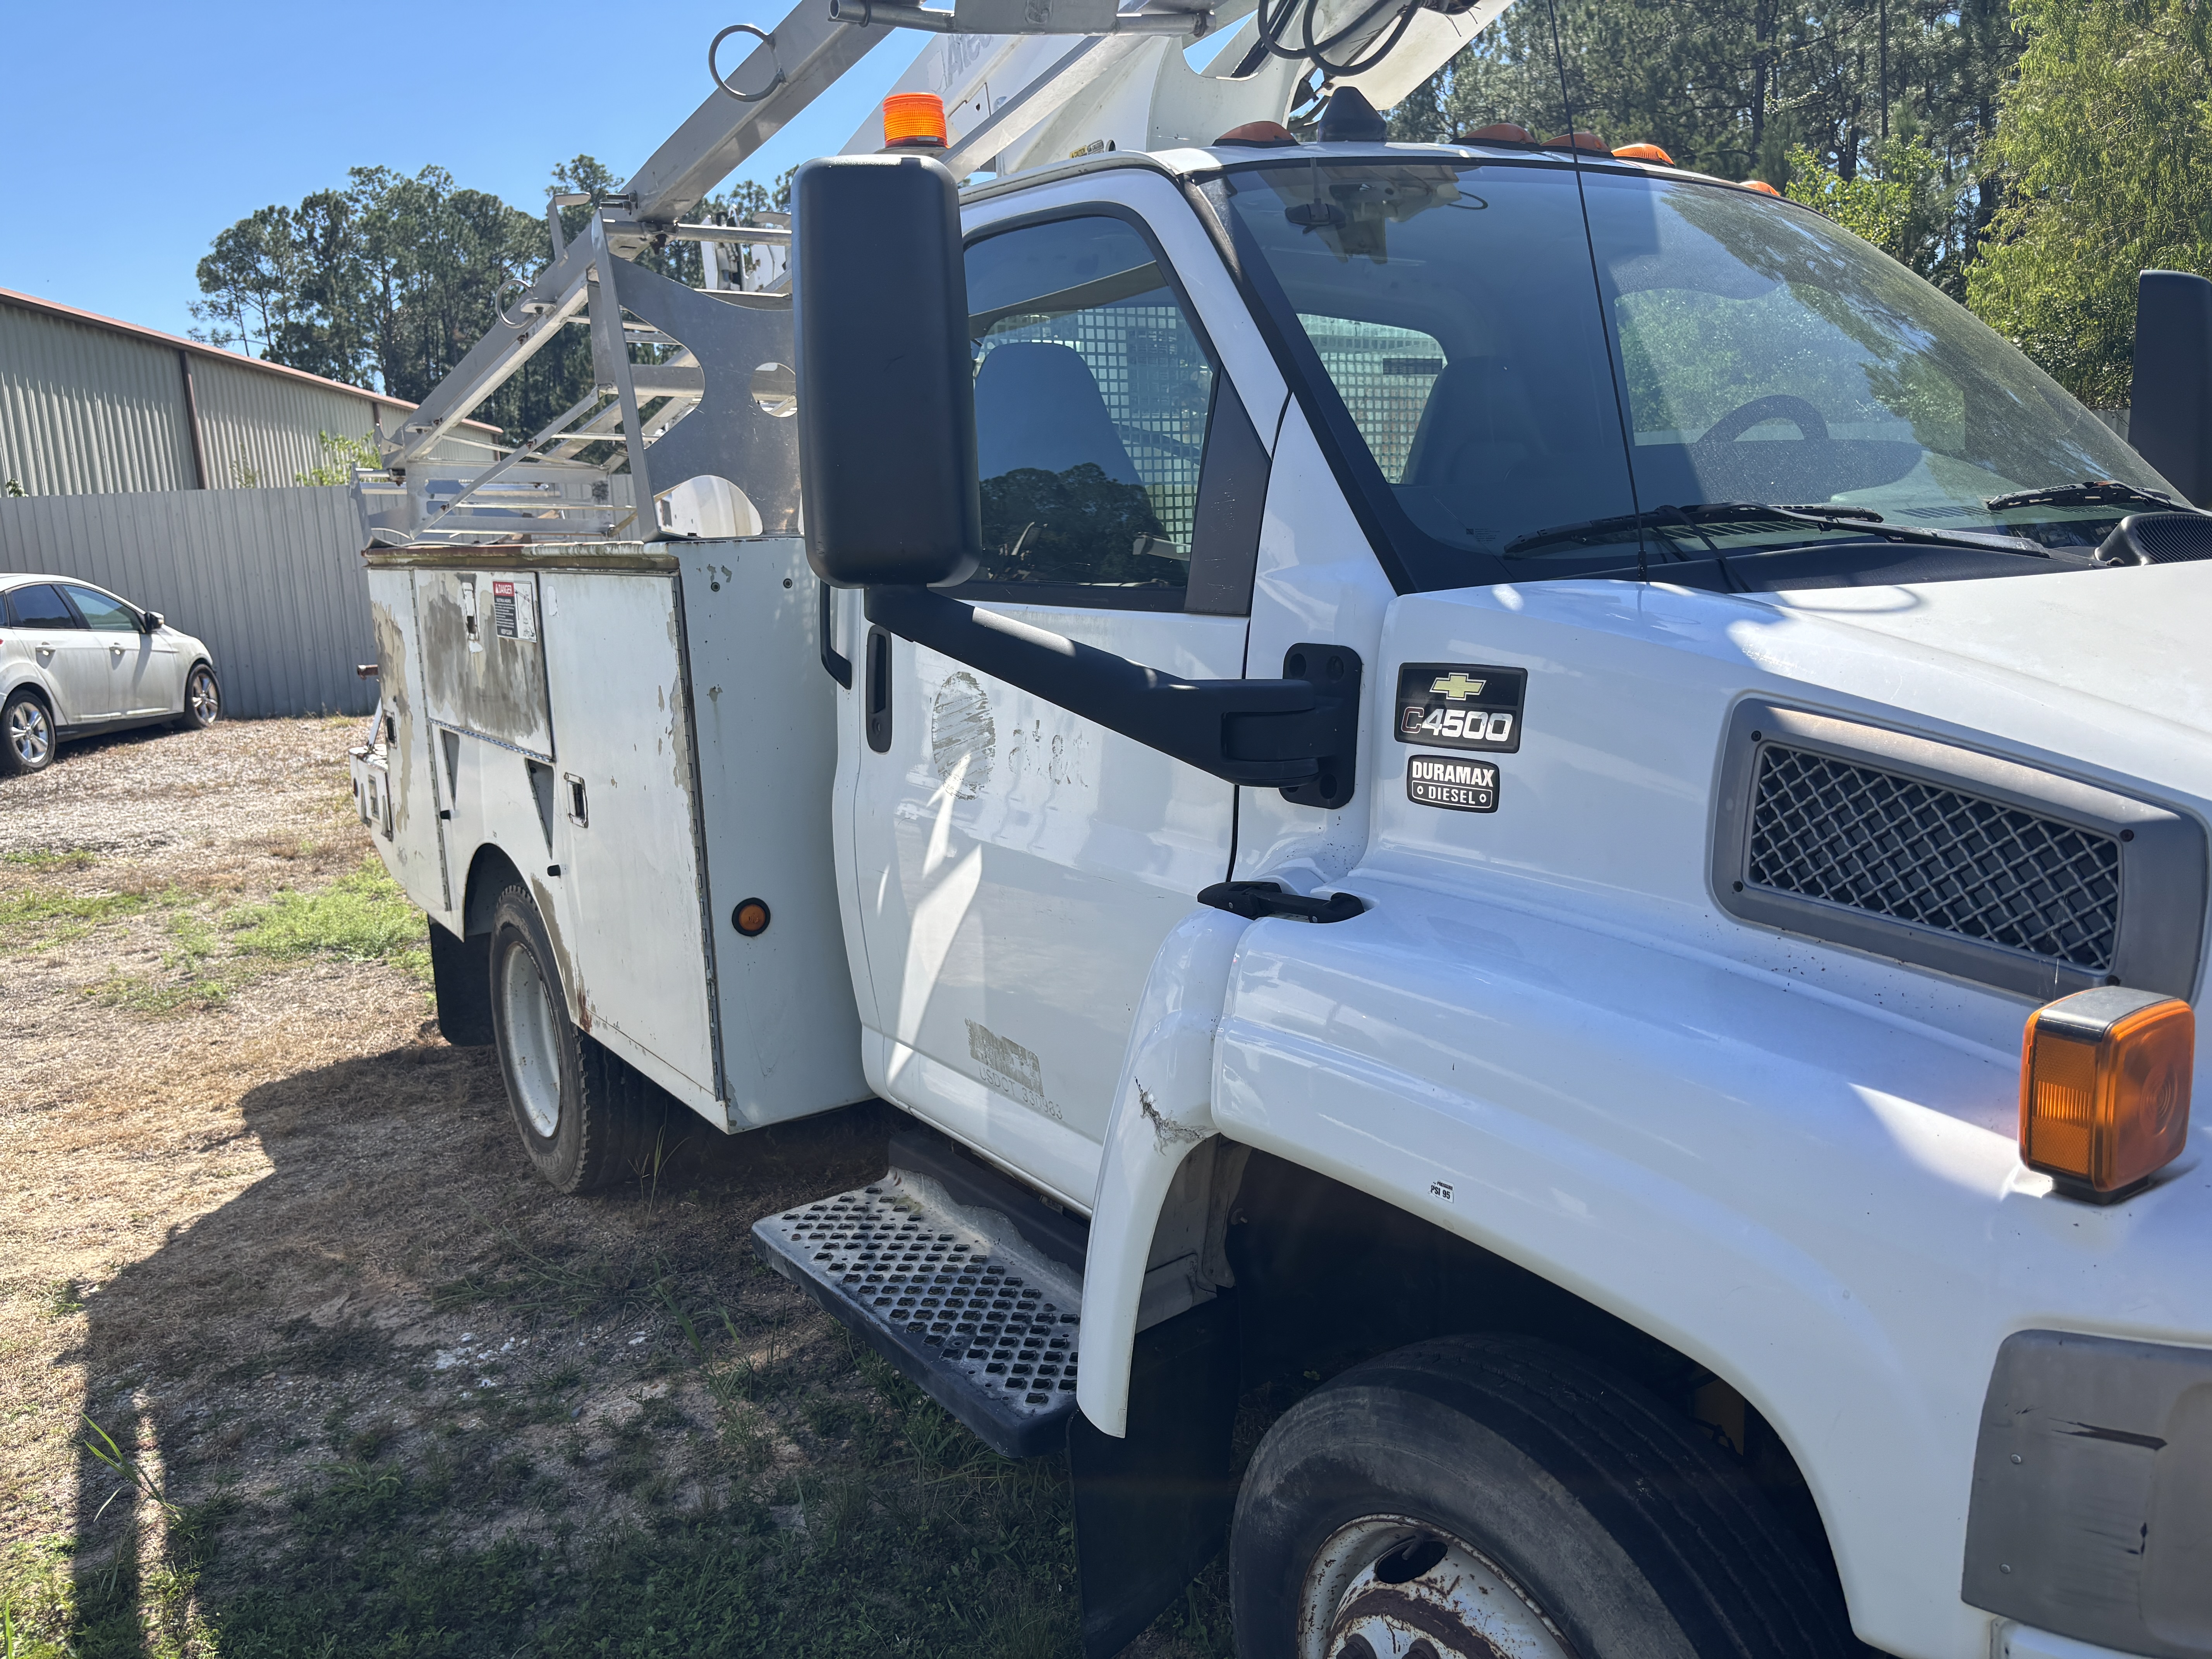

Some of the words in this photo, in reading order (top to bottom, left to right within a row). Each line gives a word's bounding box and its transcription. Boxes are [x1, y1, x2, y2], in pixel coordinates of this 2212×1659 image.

[1401, 707, 1513, 742] C4500
[1412, 761, 1494, 787] DURAMAX
[1428, 787, 1475, 804] DIESEL
[1431, 1185, 1441, 1196] PSI
[1443, 1190, 1450, 1199] 95
